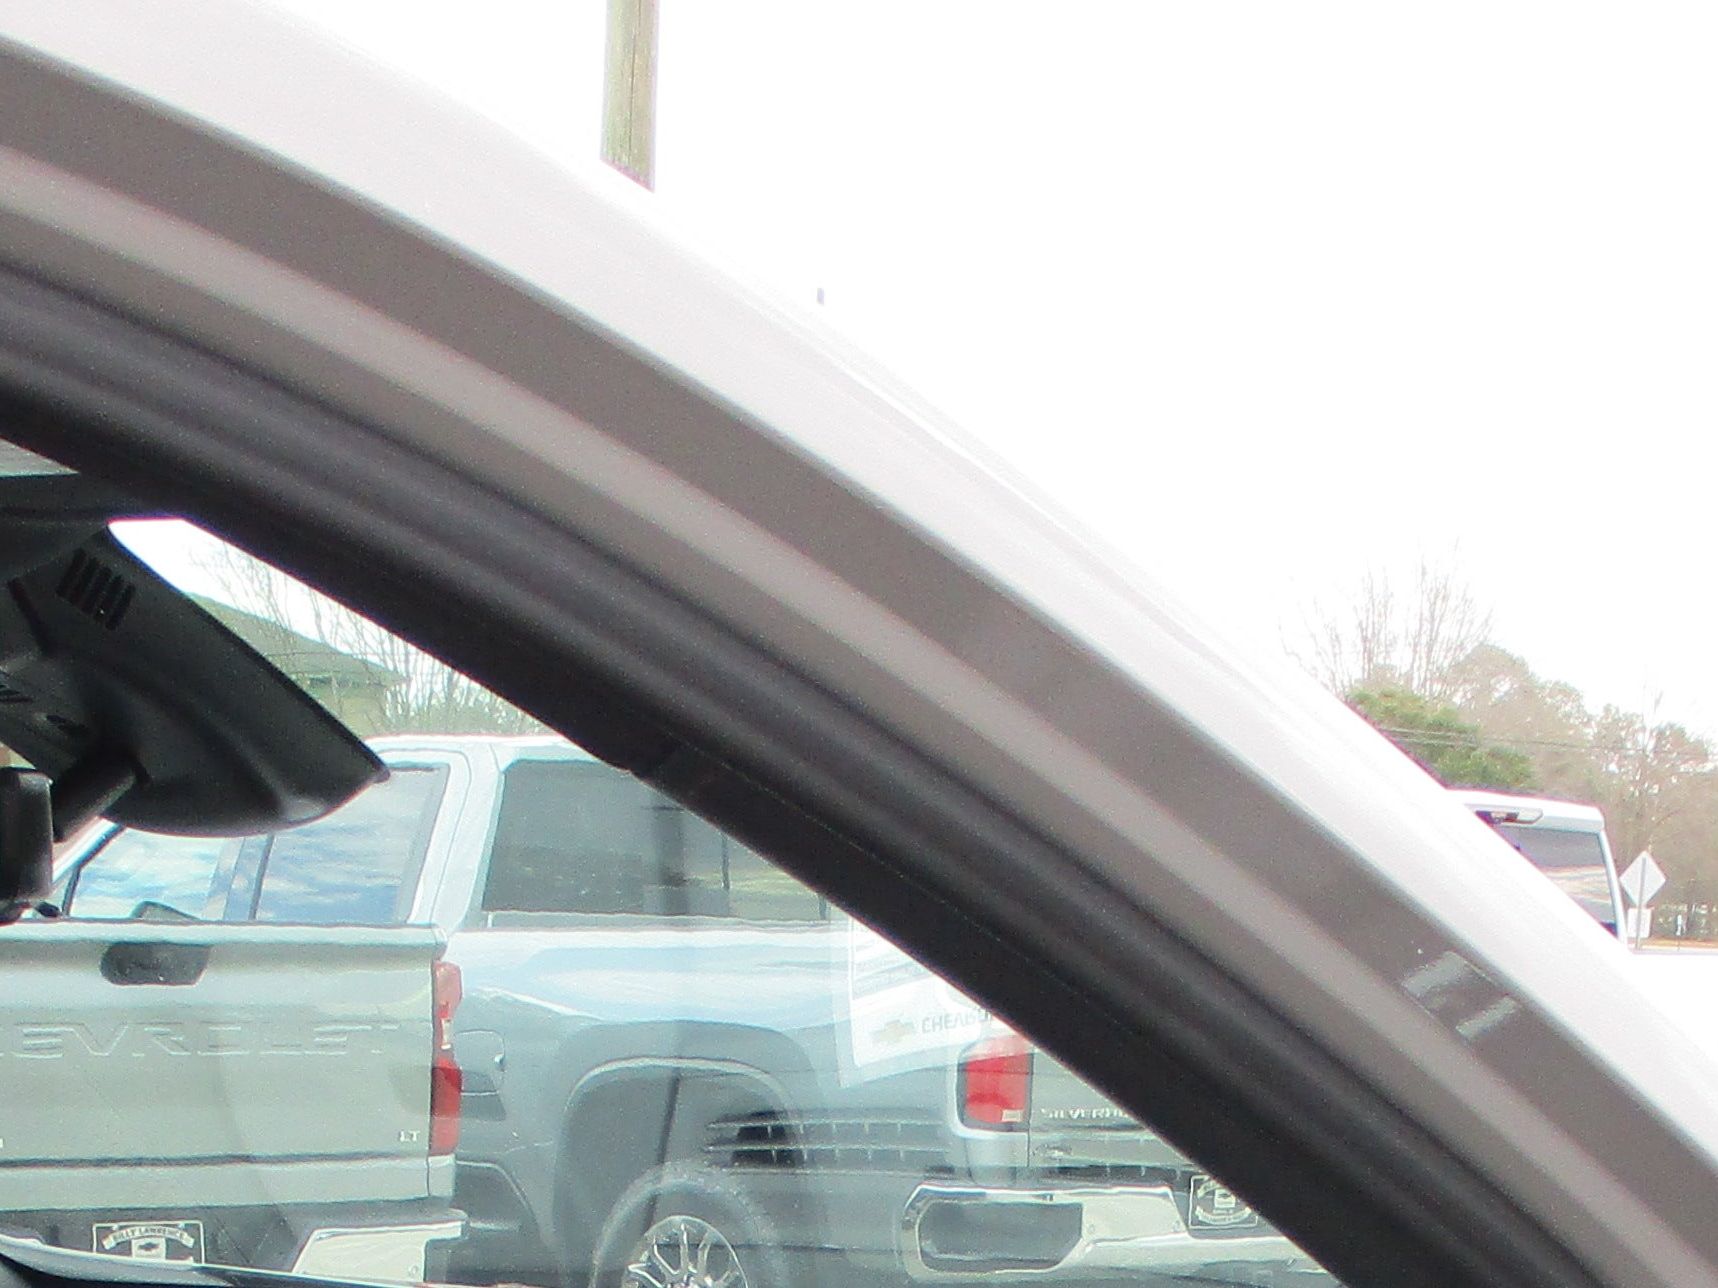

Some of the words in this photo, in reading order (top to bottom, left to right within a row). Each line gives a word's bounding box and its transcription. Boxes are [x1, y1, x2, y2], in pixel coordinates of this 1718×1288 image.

[398, 1130, 421, 1144] LT
[112, 1227, 136, 1242] BILLY
[138, 1225, 188, 1242] LAWRENCE
